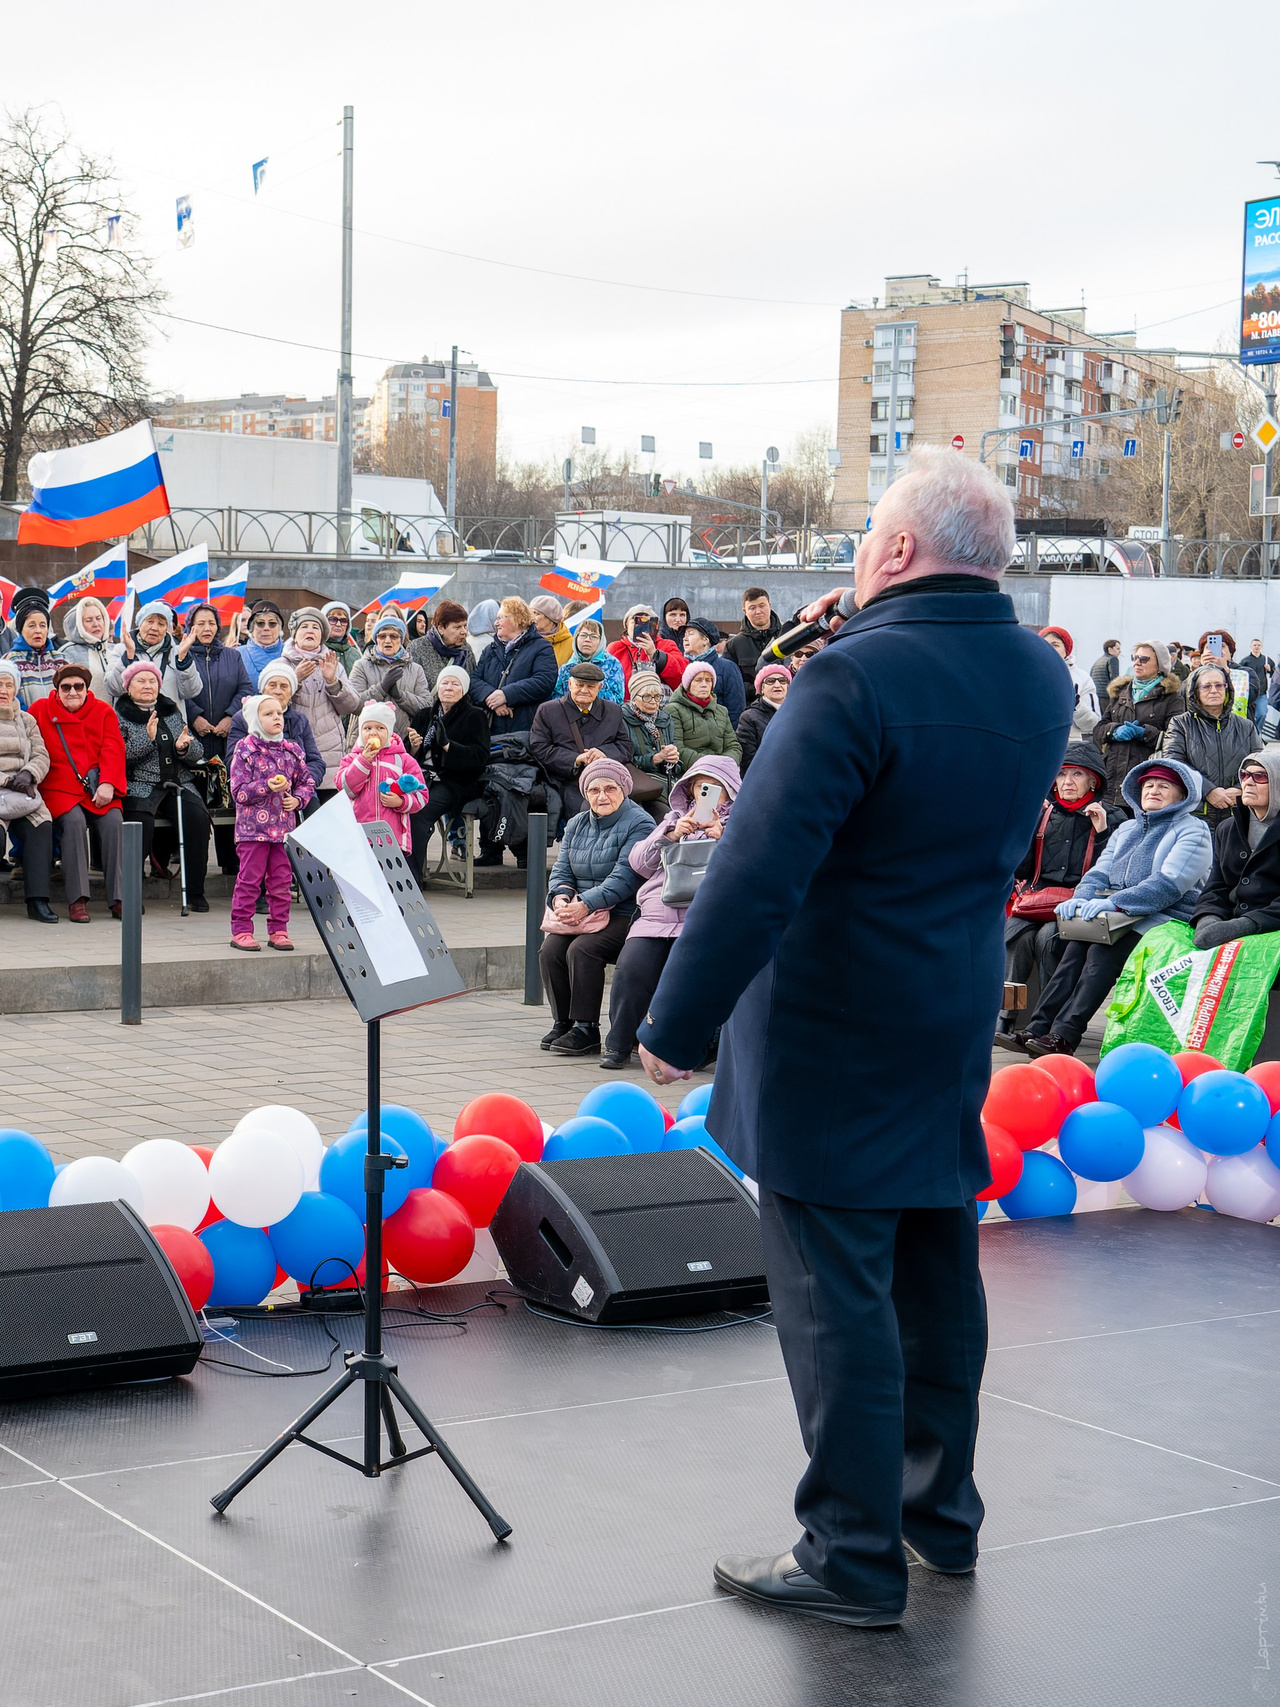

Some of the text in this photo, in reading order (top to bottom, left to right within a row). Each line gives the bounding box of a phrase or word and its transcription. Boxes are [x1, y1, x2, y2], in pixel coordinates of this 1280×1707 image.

[1134, 530, 1159, 540] СТОП
[1150, 956, 1193, 986] MERLIN
[1154, 984, 1178, 1017] LEROY
[1189, 996, 1216, 1049] БЕССПОРНО
[1206, 964, 1229, 997] НИЗКИЕ
[70, 1333, 93, 1342] FBT
